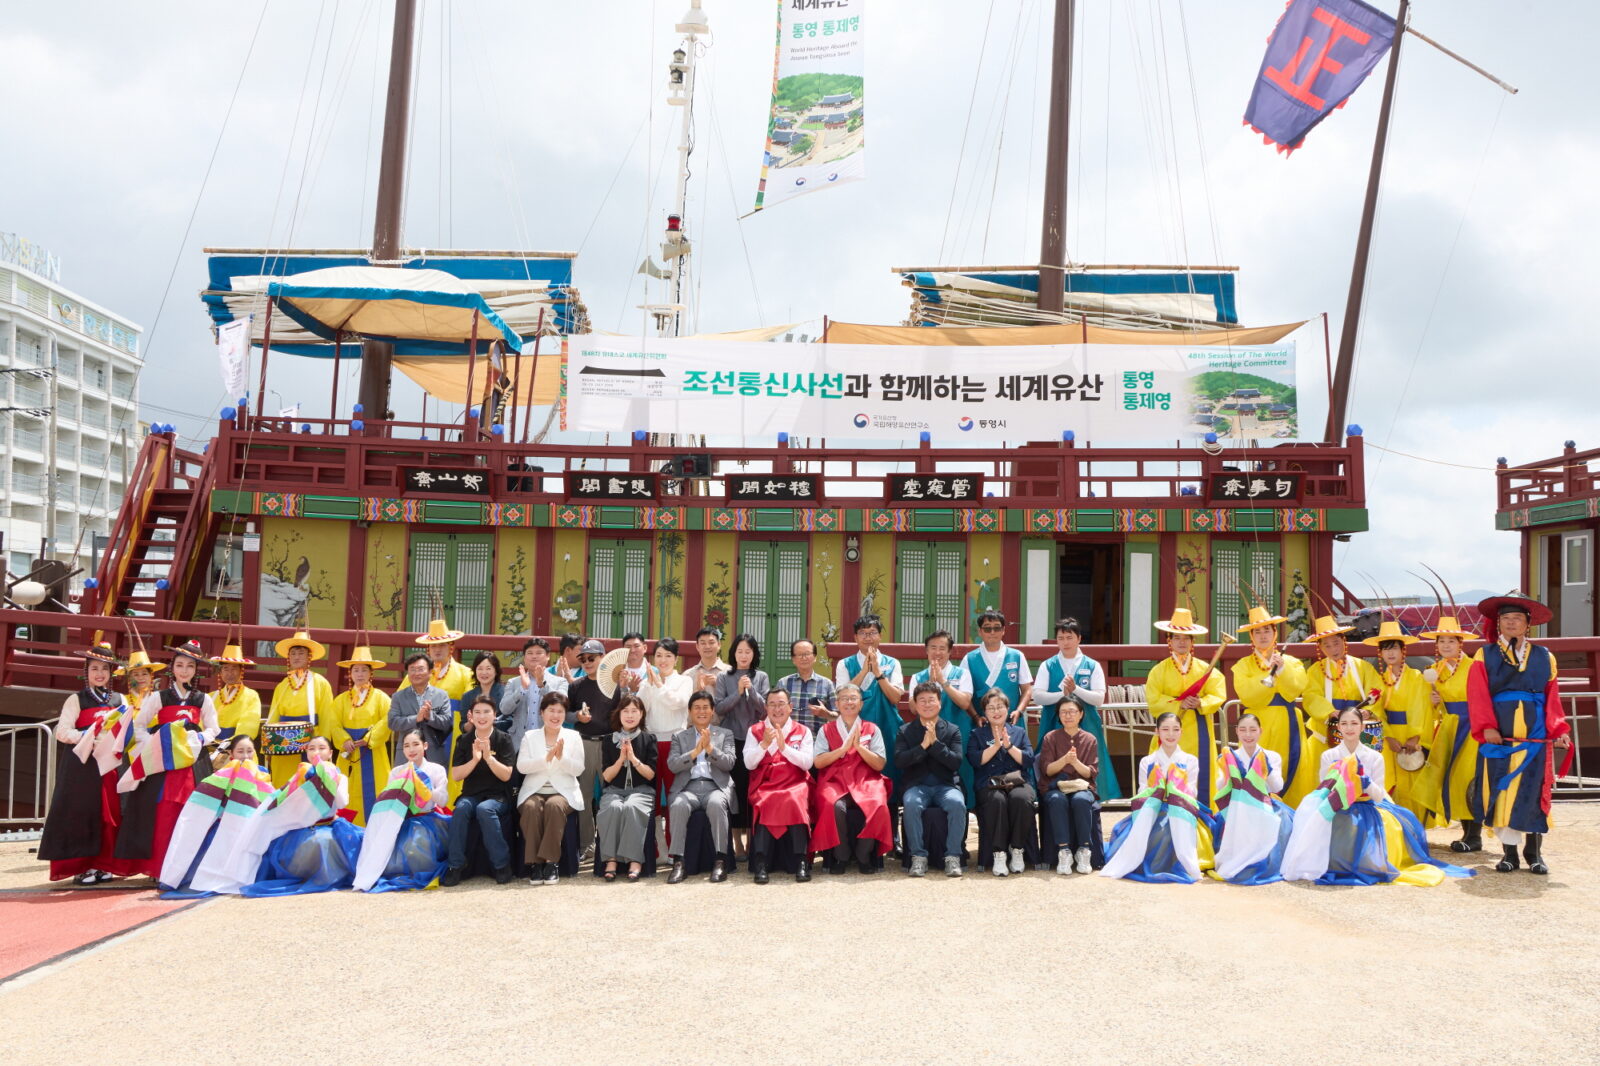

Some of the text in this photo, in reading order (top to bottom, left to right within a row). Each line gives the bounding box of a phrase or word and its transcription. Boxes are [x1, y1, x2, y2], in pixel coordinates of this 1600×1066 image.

[792, 15, 859, 38] 통영 통제영
[1209, 359, 1287, 368] Heritage Committee
[683, 370, 872, 399] 조선통신사선과
[879, 373, 987, 402] 함께하는
[995, 374, 1104, 401] 세계유산
[1123, 371, 1154, 389] 통영
[1123, 392, 1171, 410] 통제영
[979, 419, 1007, 428] 통영시
